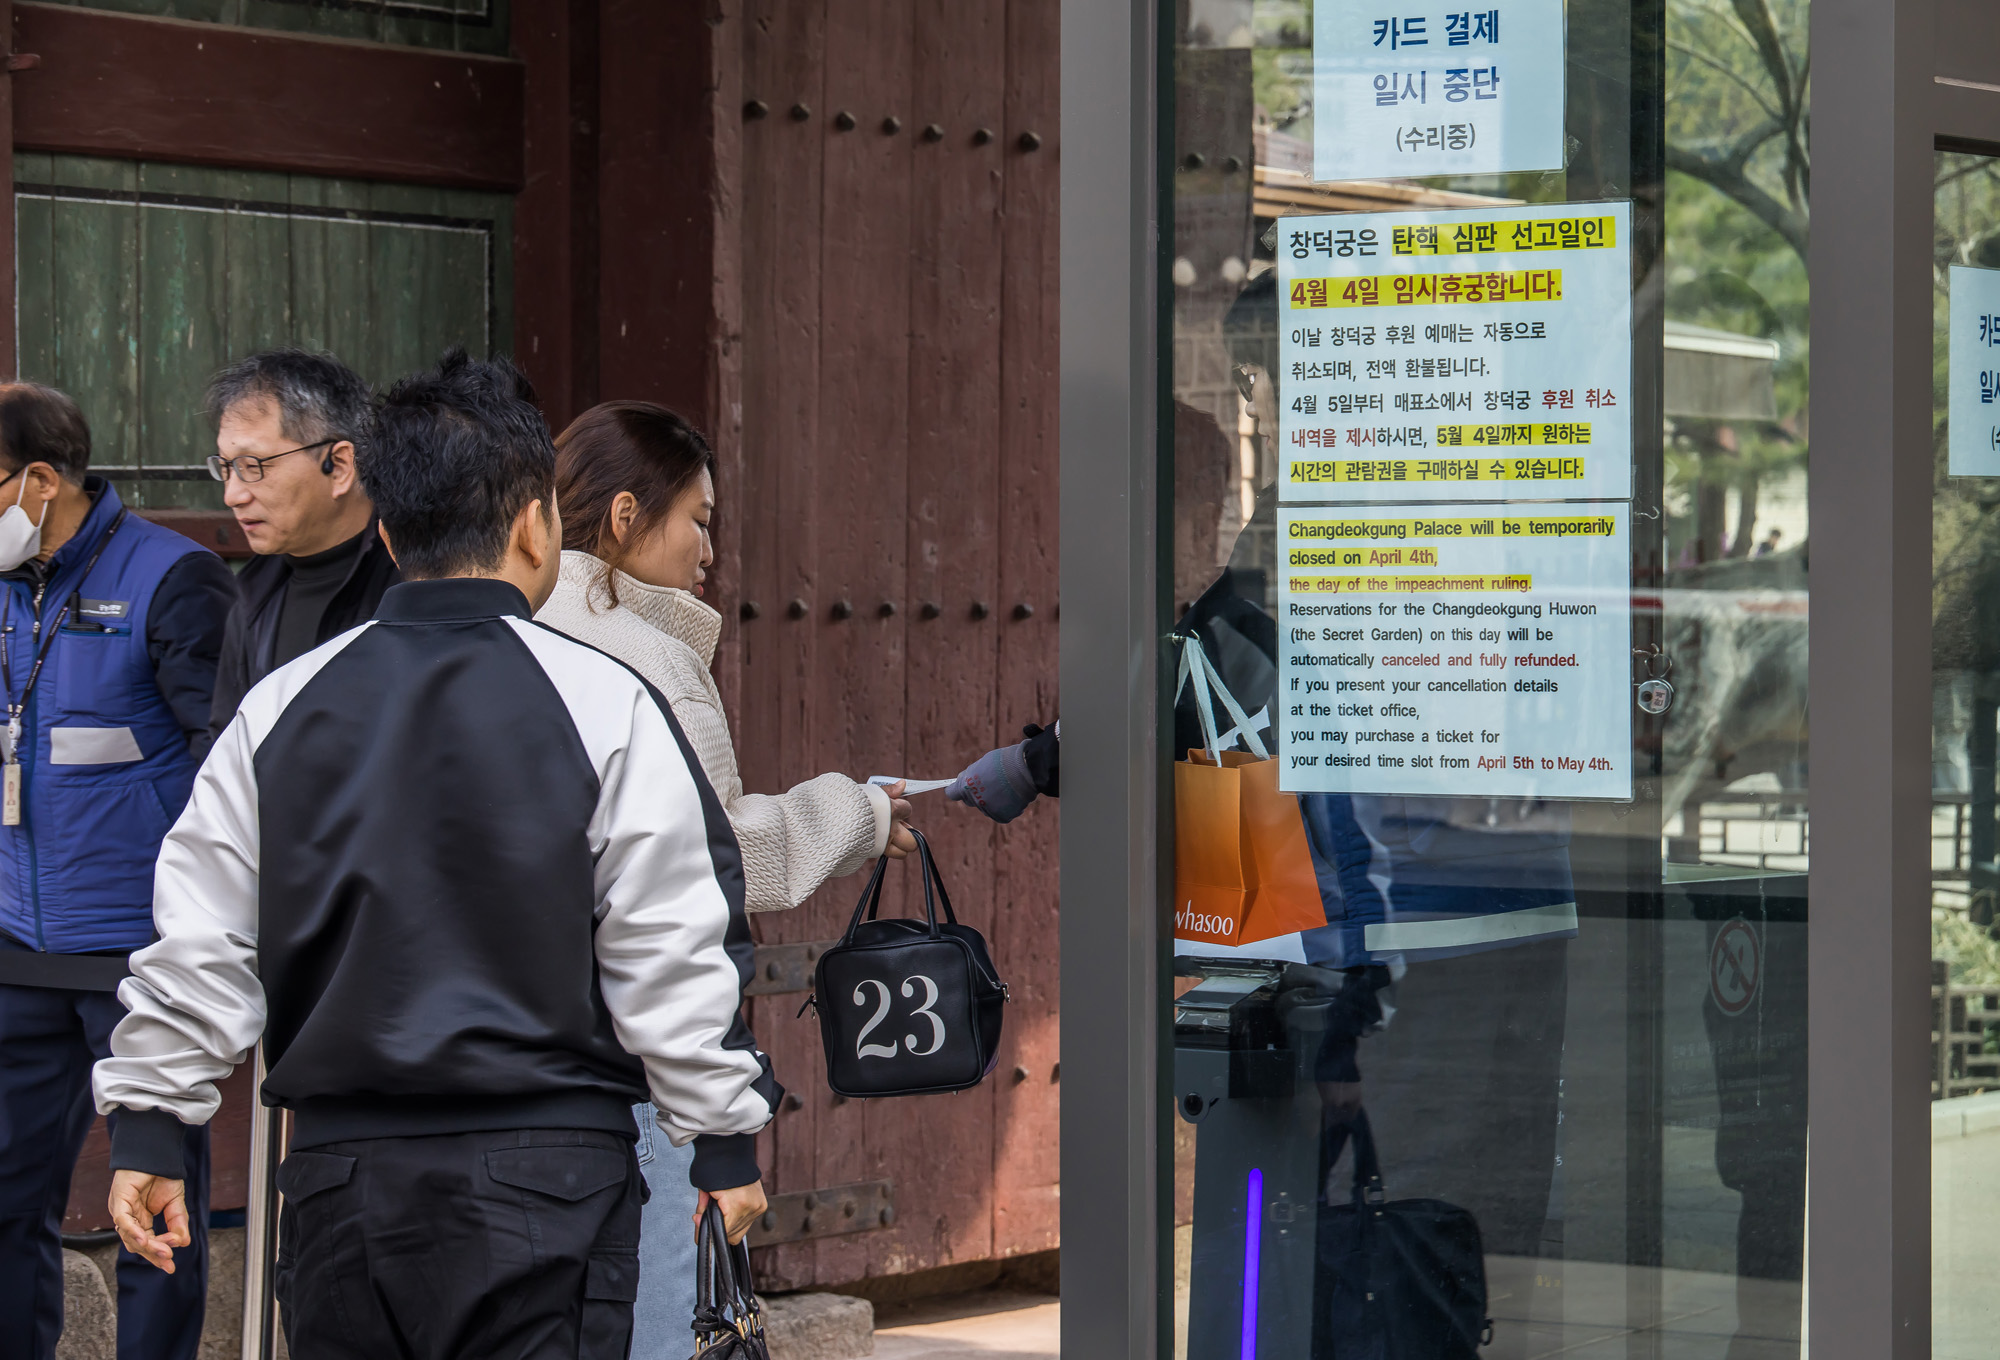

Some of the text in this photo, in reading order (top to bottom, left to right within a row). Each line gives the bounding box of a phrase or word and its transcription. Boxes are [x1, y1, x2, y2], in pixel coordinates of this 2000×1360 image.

[1373, 9, 1499, 50] 카드 결제
[1374, 66, 1500, 107] 일시 중단
[1397, 123, 1475, 152] (수리중)
[1290, 219, 1604, 259] 창덕궁은 탄핵 심판 선고일인
[1291, 271, 1561, 307] 4월 4일 임시휴궁합니다.
[1292, 322, 1546, 347] 이날 창덕궁 후원 예매는 자동으로
[1292, 356, 1490, 382] 취소되며, 전액 환불됩니다.
[1292, 389, 1616, 414] 4월 5일부터 매표소에서 창덕궁 후원 취소
[1292, 423, 1591, 449] 내역을 제시하시면, 5월 4일까지 원하는
[1291, 457, 1583, 482] 시간의 관람권을 구매하실 수 있습니다.
[1289, 519, 1614, 540] Changdeokgung Palace will be temporarily
[1289, 549, 1438, 567] closed on April 4th,
[1290, 576, 1531, 594] the day of the impeachment ruling.
[1290, 602, 1597, 618] Reservations for the Changdeokgung Huwon
[1290, 627, 1553, 644] (the Secret Garden) on this day will be
[1291, 653, 1579, 669] automatically canceled and fully refunded.
[1291, 679, 1558, 694] If you present your cancellation details
[1291, 704, 1420, 720] at the ticket office,
[1291, 730, 1500, 744] you may purchase a ticket for
[1291, 754, 1613, 773] your desired time slot from April 5th to May 4th.
[853, 975, 945, 1060] 23
